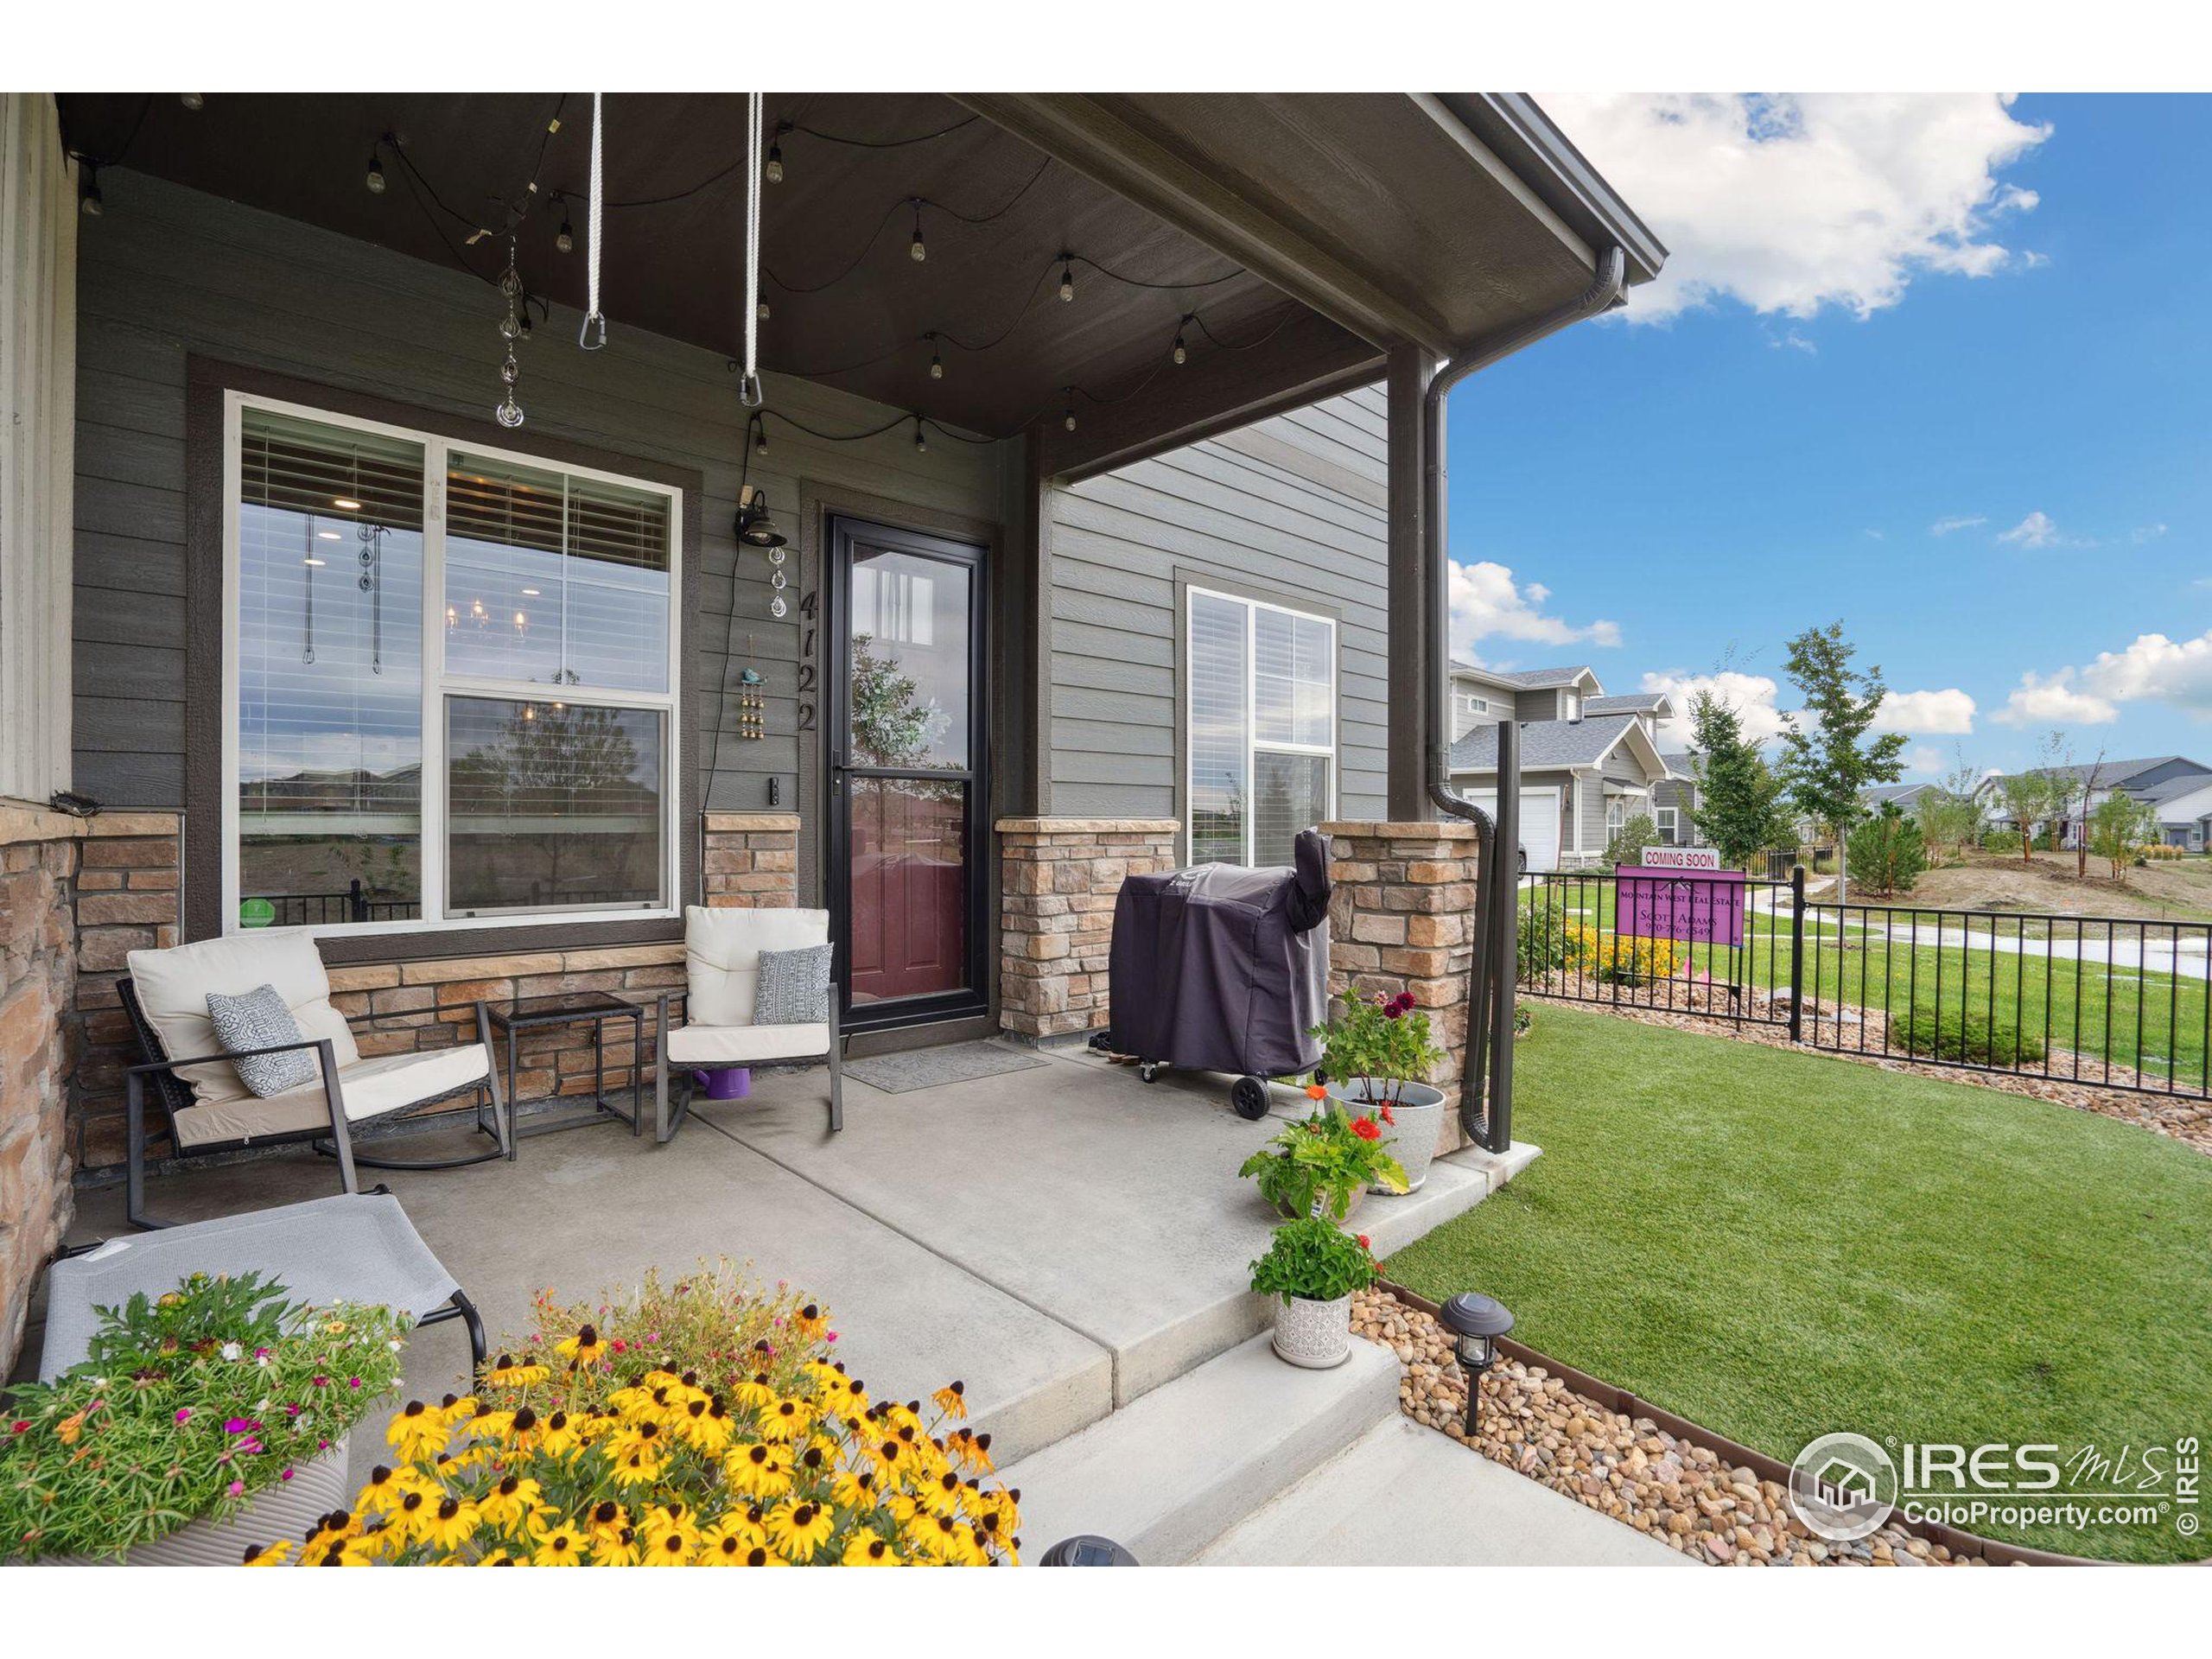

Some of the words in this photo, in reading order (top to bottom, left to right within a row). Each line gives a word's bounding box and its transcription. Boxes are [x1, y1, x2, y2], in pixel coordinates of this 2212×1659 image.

[799, 591, 817, 731] 4122
[1646, 852, 1683, 866] COMING
[1686, 853, 1714, 867] SOON
[1621, 891, 1663, 900] MONTAIN
[1710, 897, 1740, 906] ESTAE
